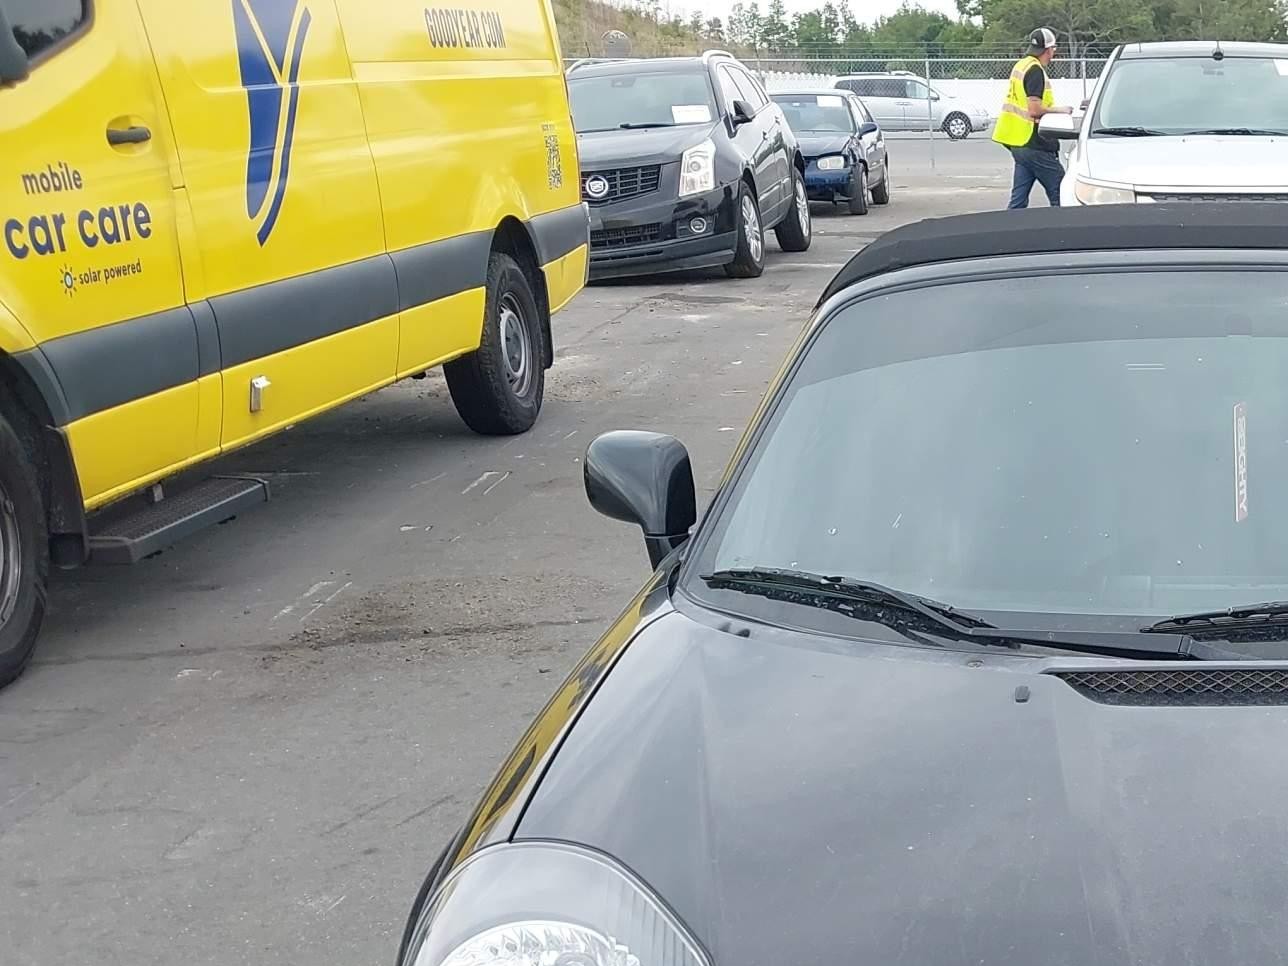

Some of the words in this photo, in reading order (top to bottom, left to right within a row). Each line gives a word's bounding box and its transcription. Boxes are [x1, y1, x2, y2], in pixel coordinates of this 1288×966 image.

[22, 161, 83, 195] mobile
[5, 212, 66, 259] car
[78, 202, 152, 248] care
[79, 267, 101, 285] solar
[104, 258, 142, 285] powered
